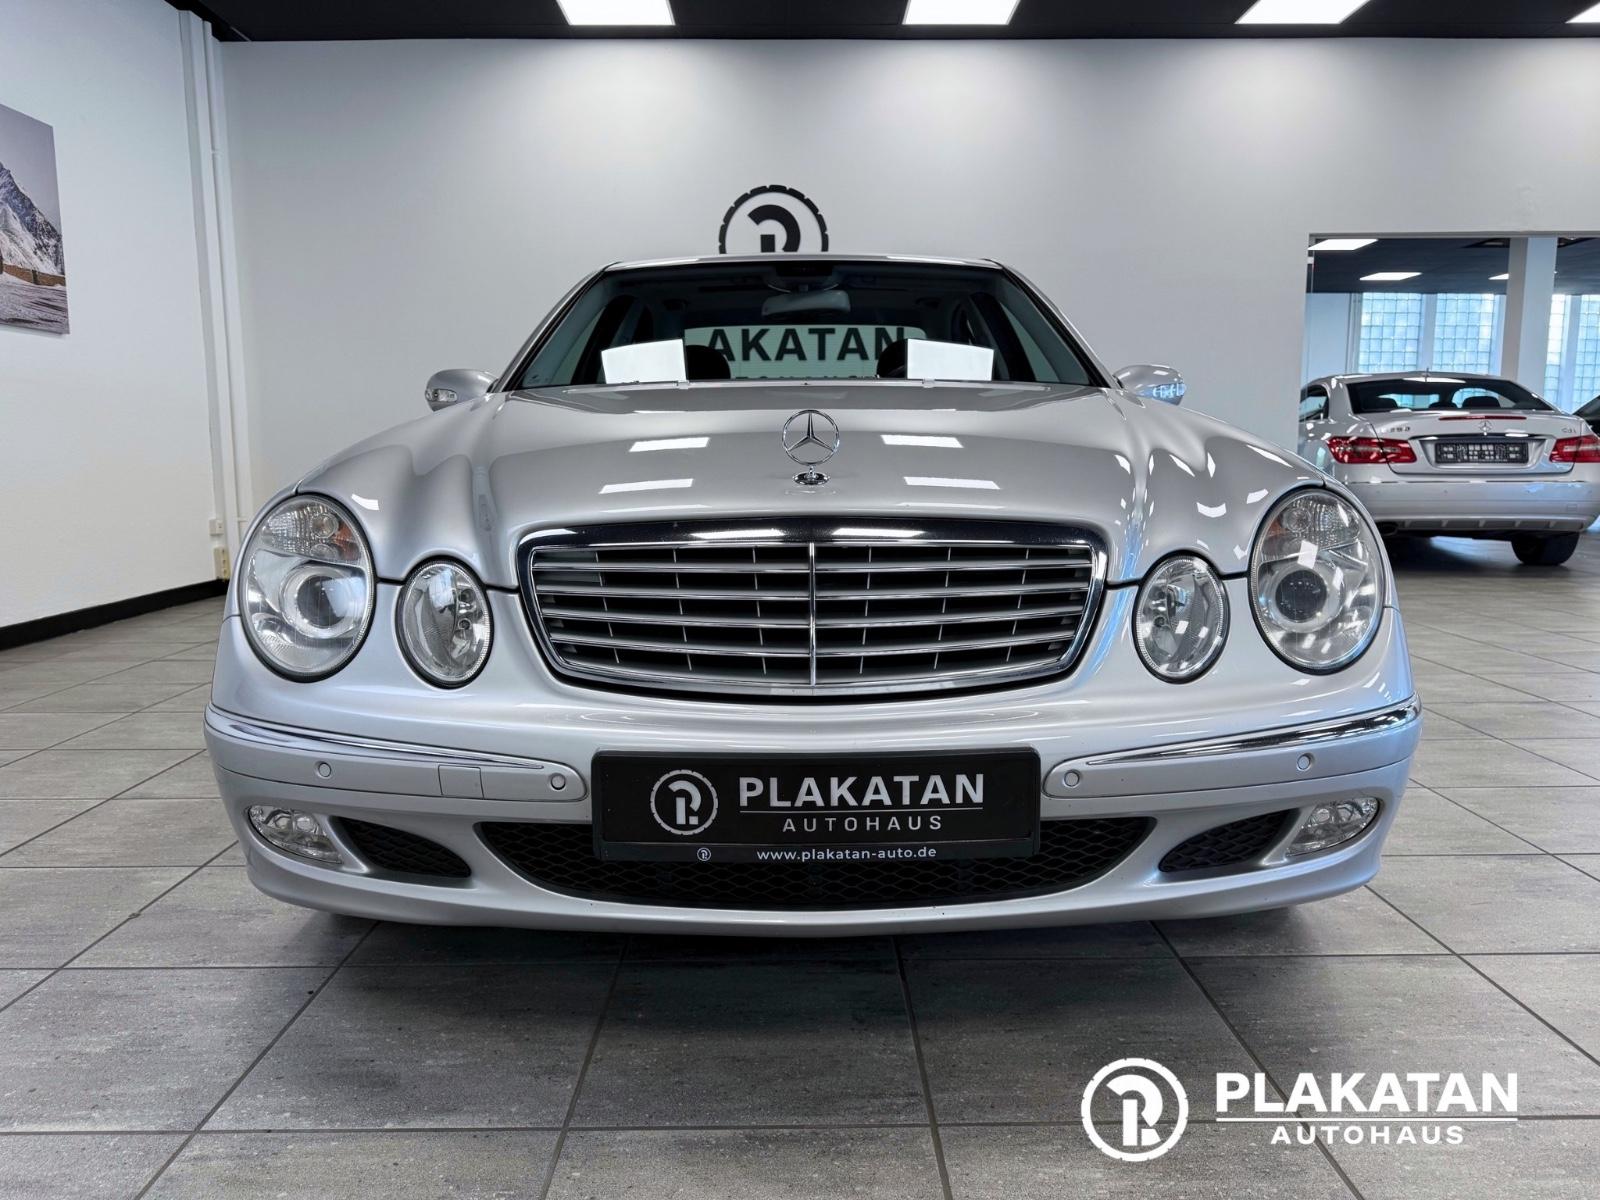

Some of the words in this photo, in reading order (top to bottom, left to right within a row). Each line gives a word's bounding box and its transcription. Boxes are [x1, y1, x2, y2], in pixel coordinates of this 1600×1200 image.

[739, 774, 985, 808] PLAKATAN
[782, 816, 942, 832] AUTOHAUS
[757, 847, 937, 862] www.plakatan-auto.de
